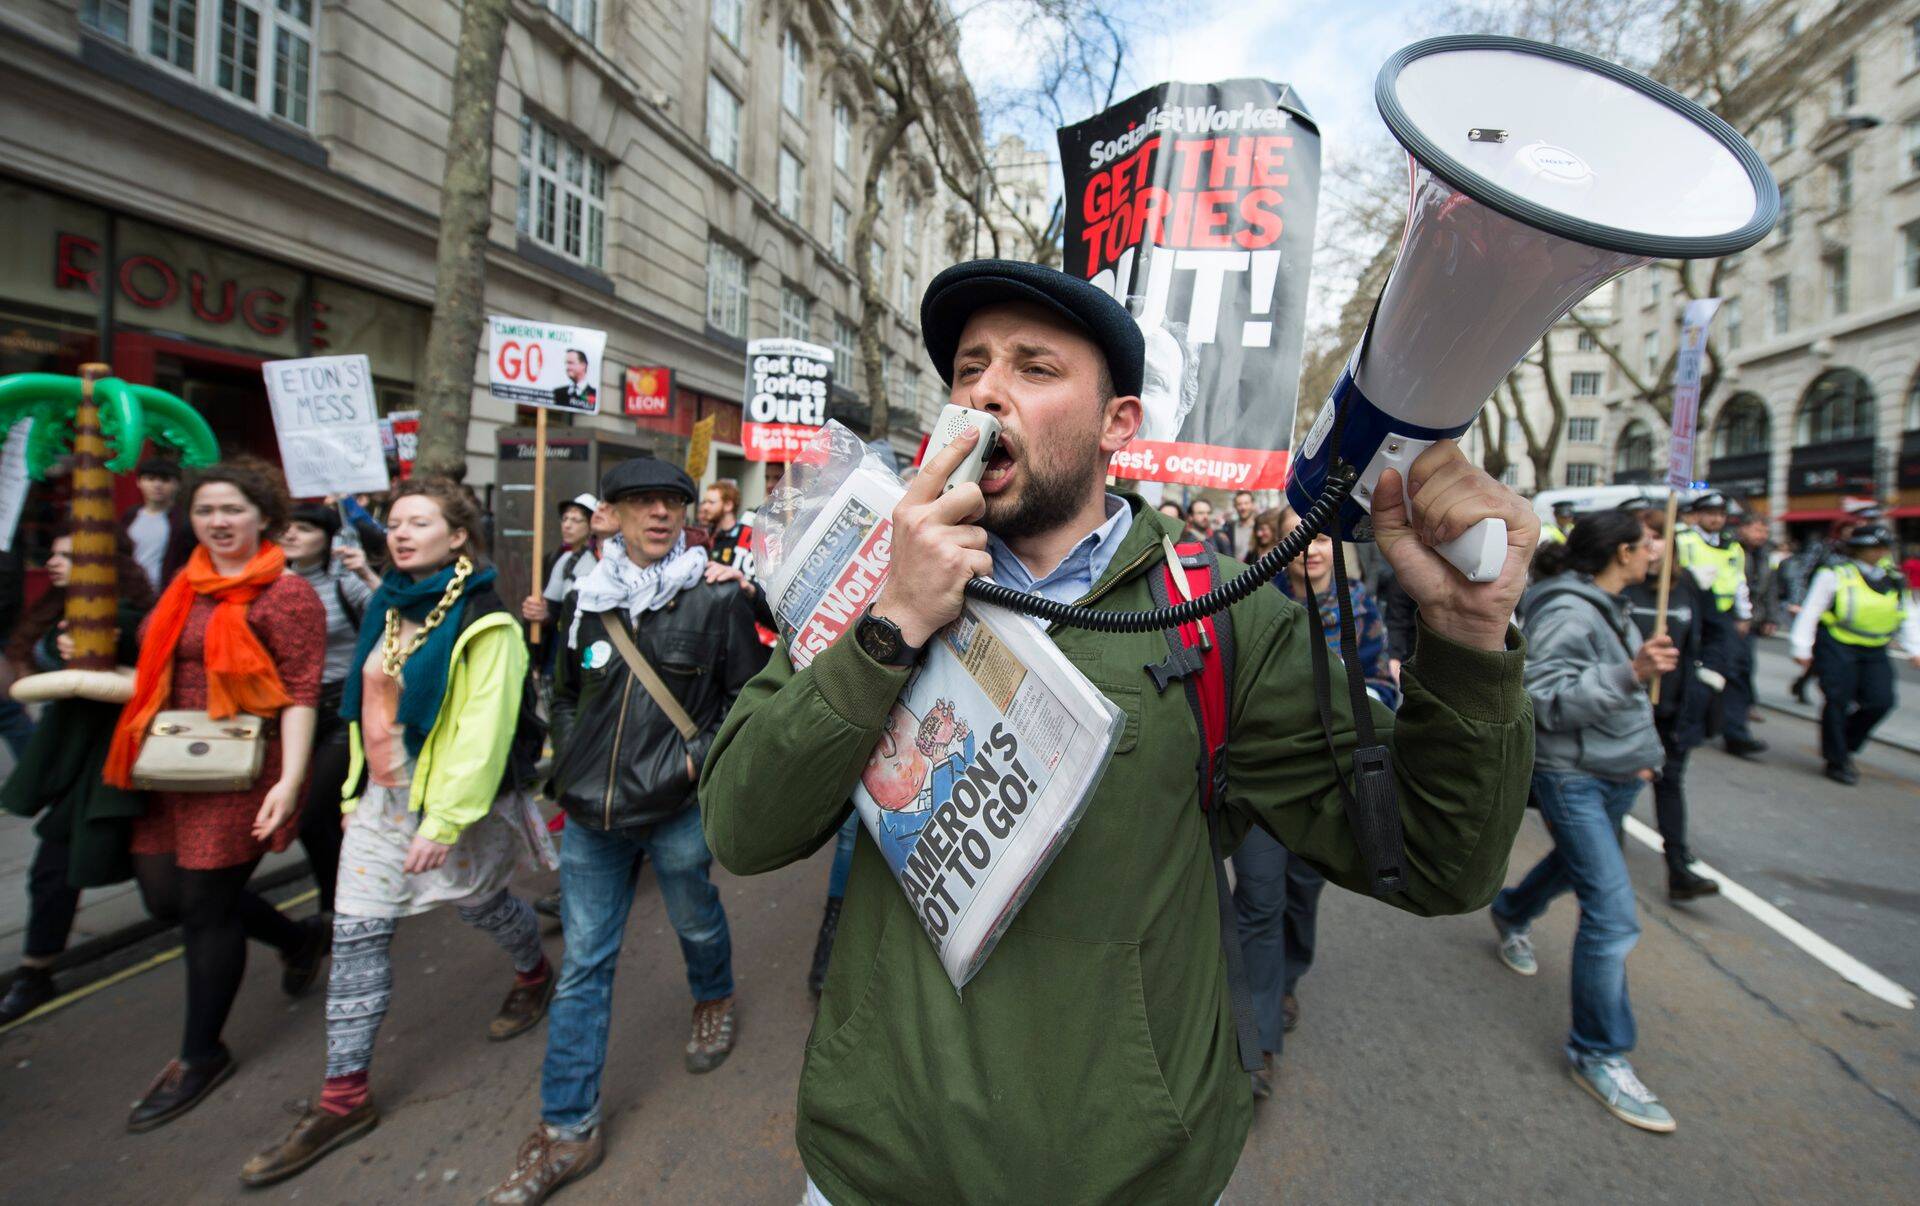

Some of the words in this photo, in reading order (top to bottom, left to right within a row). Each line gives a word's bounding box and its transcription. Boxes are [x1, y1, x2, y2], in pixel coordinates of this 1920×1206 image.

[1090, 103, 1185, 170] Socialist
[1184, 102, 1293, 133] Worker
[1083, 137, 1162, 223] GET
[1174, 136, 1293, 189] THE
[1082, 187, 1284, 278] TORIES
[56, 233, 331, 349] ROUGE
[495, 322, 543, 339] CAMERON
[280, 359, 360, 393] ETON'S
[498, 340, 543, 383] GO
[754, 355, 790, 375] Get
[792, 357, 827, 379] the
[628, 396, 666, 412] LEON
[753, 372, 827, 397] Tories
[297, 393, 356, 425] MESS
[750, 392, 826, 427] Out!
[516, 444, 572, 458] Telehone
[1110, 449, 1160, 475] test,
[1165, 455, 1252, 482] occupy
[780, 571, 811, 617] FIGHT
[803, 546, 832, 578] FOR
[823, 503, 864, 549] STEEL
[815, 524, 893, 626] Worker
[900, 721, 1018, 908] AMERON'S
[945, 828, 991, 890] TO
[982, 757, 1039, 840] GO!
